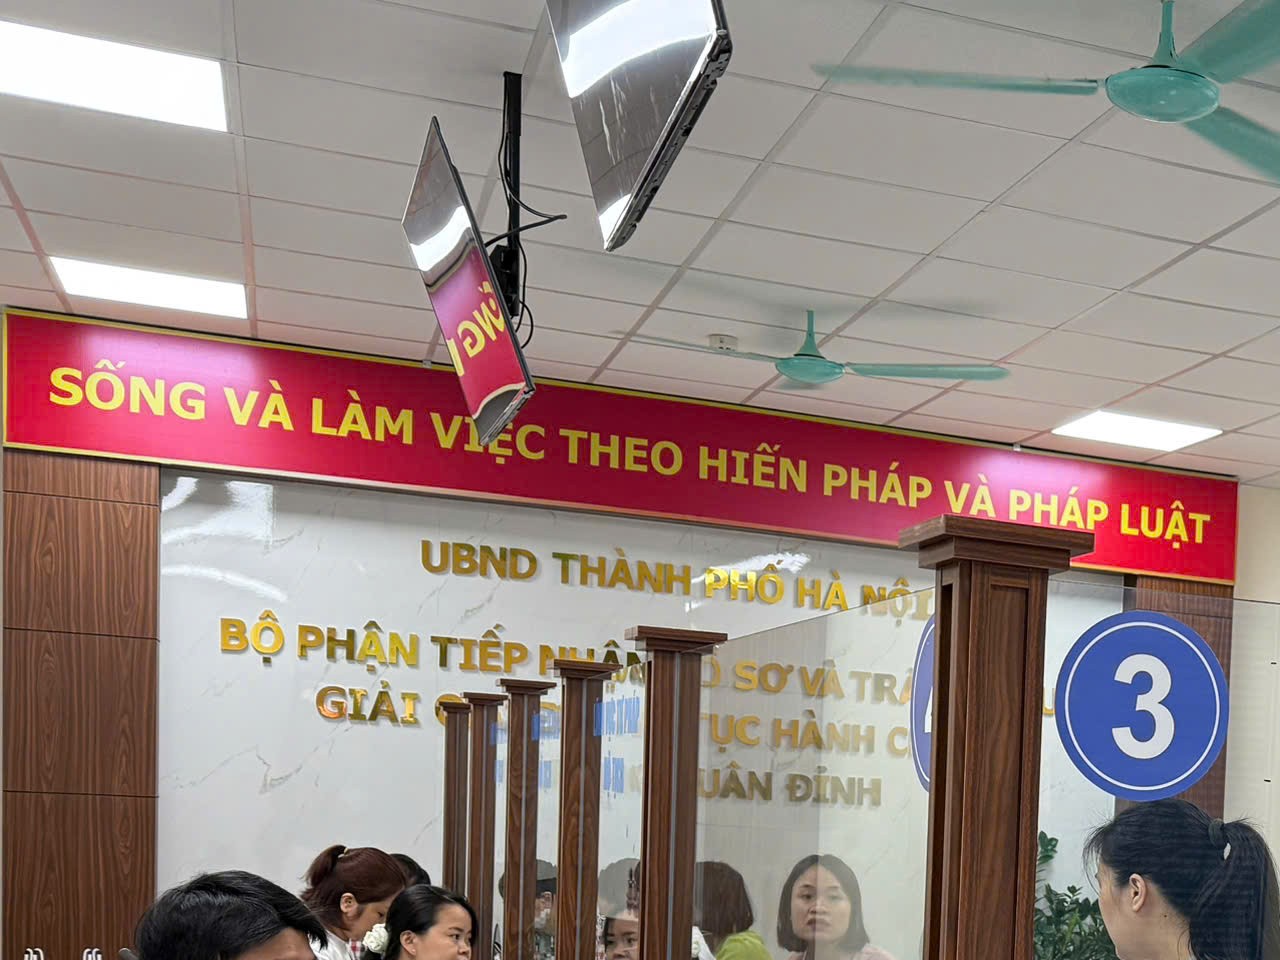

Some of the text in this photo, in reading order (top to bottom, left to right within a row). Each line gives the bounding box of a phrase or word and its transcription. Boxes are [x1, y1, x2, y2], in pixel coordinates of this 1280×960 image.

[49, 359, 206, 420] SỐNG
[223, 380, 294, 431] VÀ
[311, 390, 414, 445] LÀM
[559, 428, 683, 476] THEO
[699, 442, 807, 493] HIẾN
[823, 463, 932, 507] PHÁP
[944, 474, 996, 517] VÀ
[1009, 487, 1110, 531] PHÁP
[1120, 502, 1211, 549] LUẬT
[420, 540, 934, 626] UBND THÀNH PHỐ HÀ NỘI
[219, 610, 285, 666] BỘ
[297, 620, 419, 672] PHẬN
[430, 623, 528, 674] TIẾP
[735, 660, 794, 694] SƠ
[799, 658, 845, 699] VÀ
[315, 680, 419, 725] GIẢI
[700, 713, 761, 753] ỤC
[773, 709, 875, 756] HÀNH
[1112, 654, 1175, 759] 3
[698, 760, 882, 807] UÂN ĐỈNH
